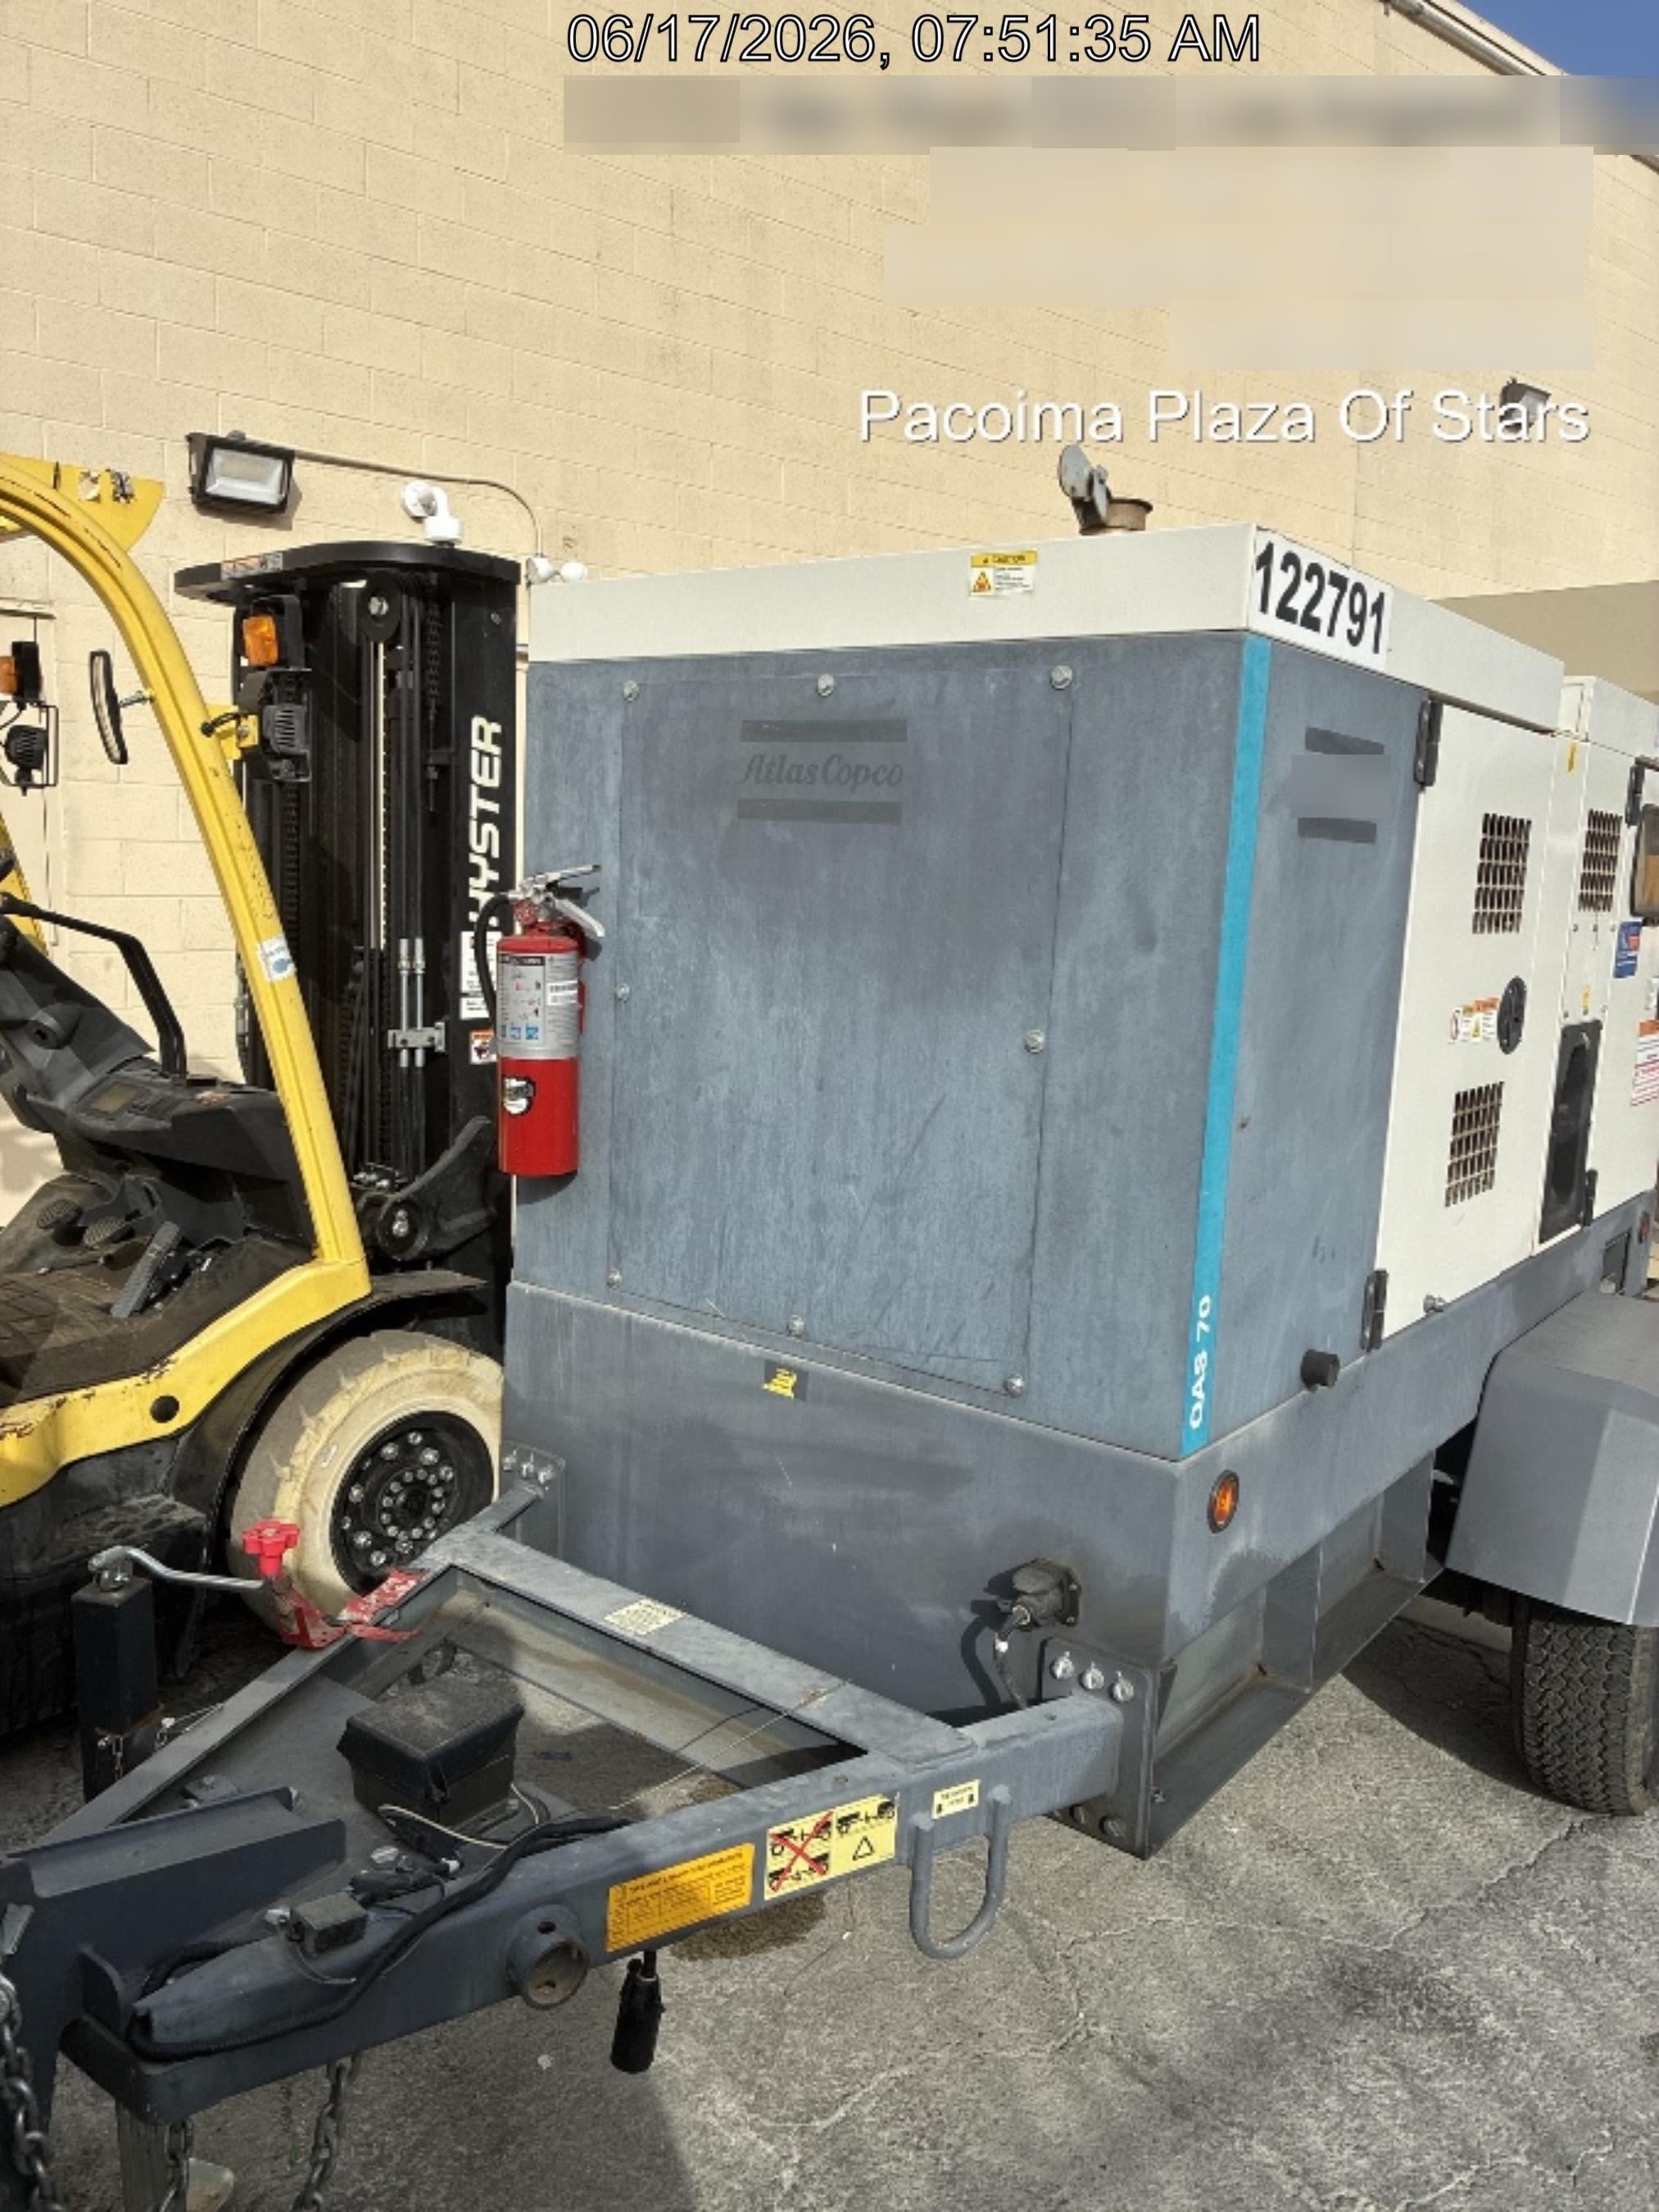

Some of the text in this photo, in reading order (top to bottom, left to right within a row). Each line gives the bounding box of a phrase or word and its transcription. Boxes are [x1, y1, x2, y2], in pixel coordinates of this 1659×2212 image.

[1255, 540, 1385, 655] 122791
[740, 752, 904, 794] Atlas Copco
[1190, 1295, 1211, 1429] QAS 70
